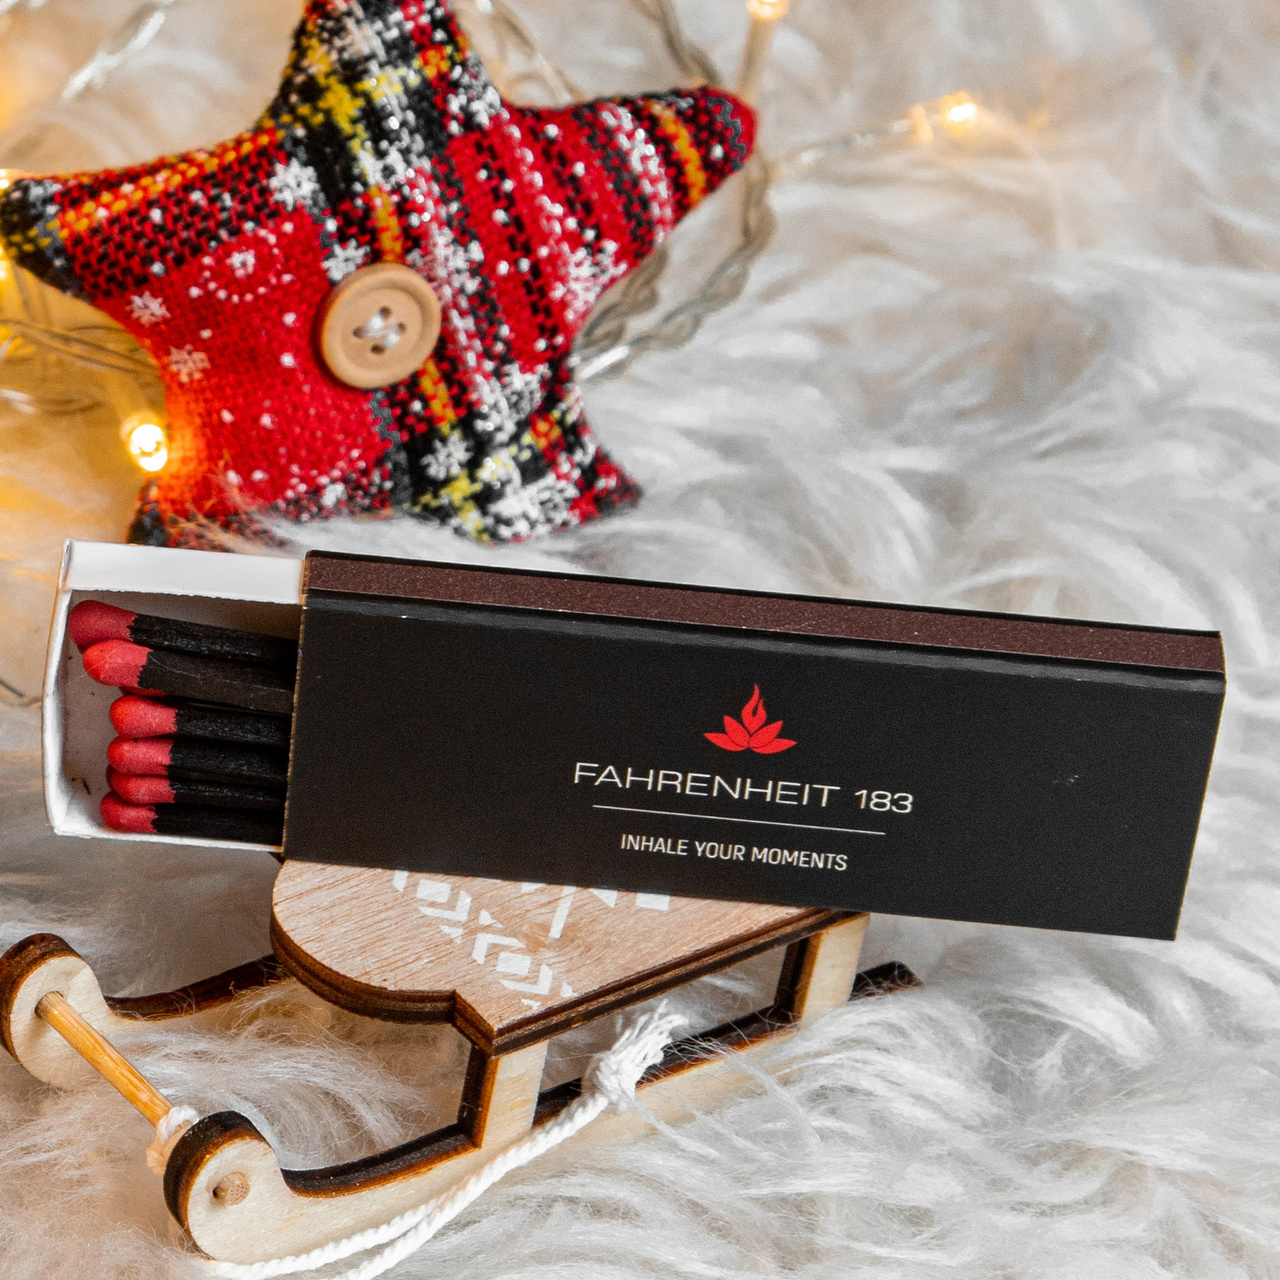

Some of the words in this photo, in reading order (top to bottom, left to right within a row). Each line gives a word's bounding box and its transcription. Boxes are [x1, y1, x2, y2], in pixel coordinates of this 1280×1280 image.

[573, 762, 840, 807] FAHRENHEIT
[854, 789, 914, 813] 183
[621, 834, 689, 857] INHALE
[694, 840, 746, 862] YOUR
[751, 847, 849, 872] MOMENTS
